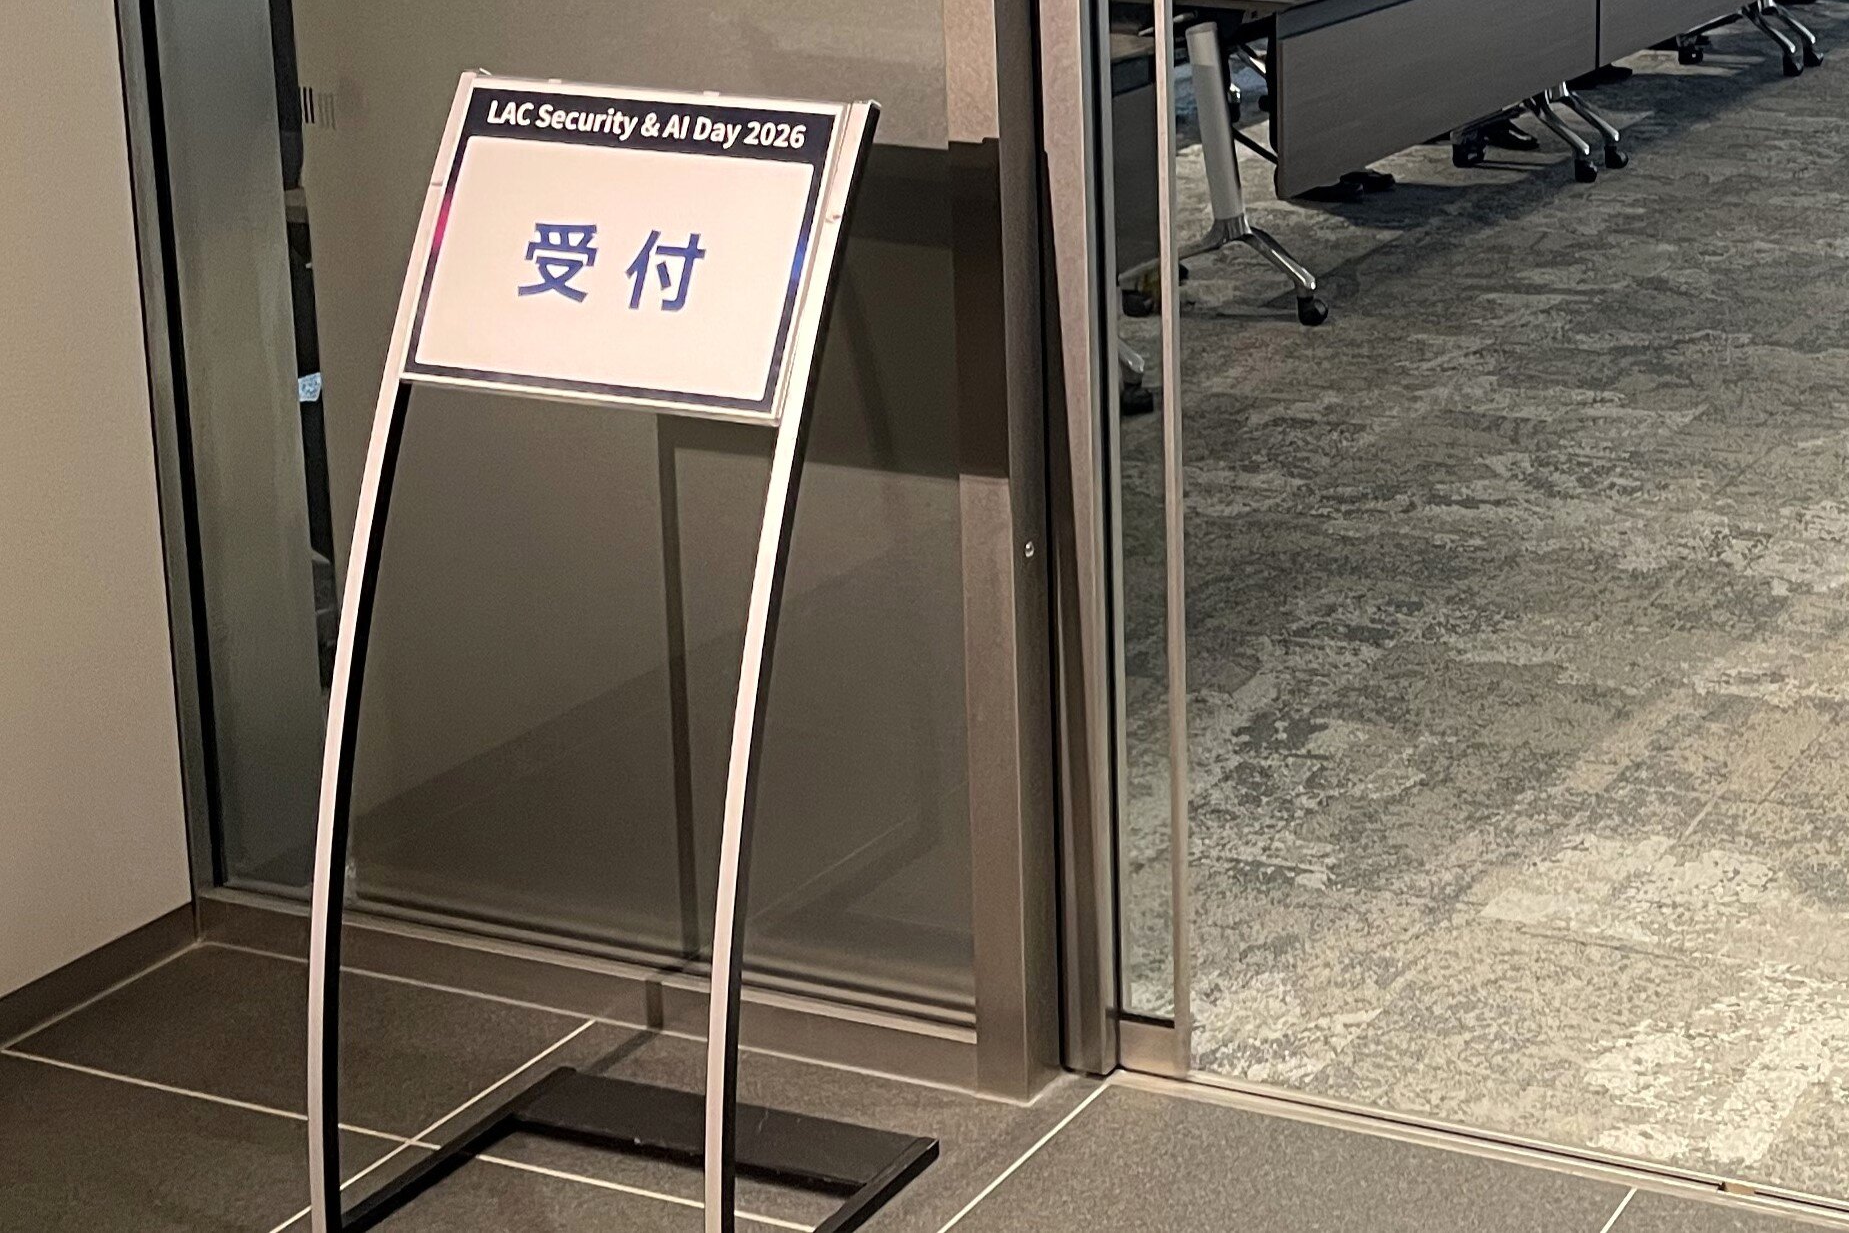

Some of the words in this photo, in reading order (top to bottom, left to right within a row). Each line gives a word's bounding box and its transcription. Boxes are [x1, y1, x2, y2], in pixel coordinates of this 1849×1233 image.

[487, 99, 535, 126] LAC
[535, 103, 638, 141] Security
[640, 112, 661, 139] &
[662, 114, 690, 141] AI
[692, 116, 742, 149] Day
[743, 121, 807, 149] 2026
[517, 223, 706, 312] 受付
